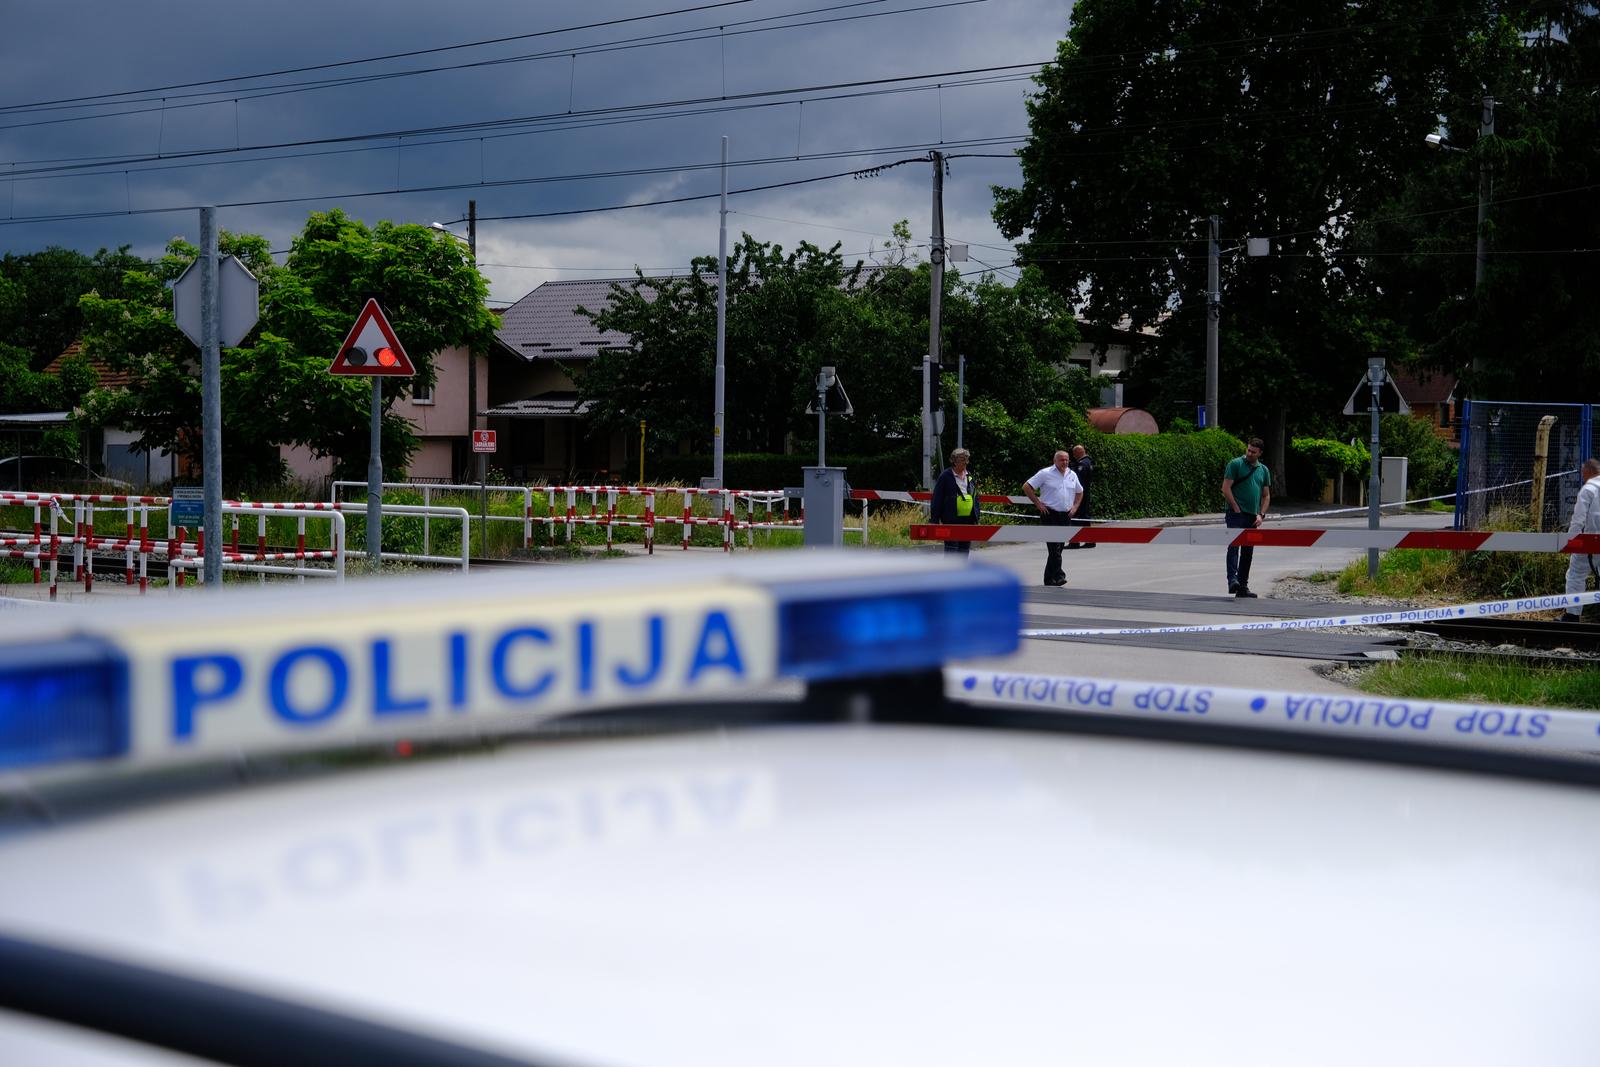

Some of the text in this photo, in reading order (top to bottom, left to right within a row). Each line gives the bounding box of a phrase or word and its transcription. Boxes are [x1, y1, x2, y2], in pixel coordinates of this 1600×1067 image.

[1280, 619, 1334, 630] POLICIJA
[1360, 613, 1393, 625] STOP
[1400, 608, 1453, 621] POLICIJA
[1479, 602, 1509, 615] STOP
[1516, 596, 1569, 611] POLICIJA
[168, 609, 747, 740] POLICIJA
[992, 674, 1551, 738] STOP POLICIJA STOP POLICIJA
